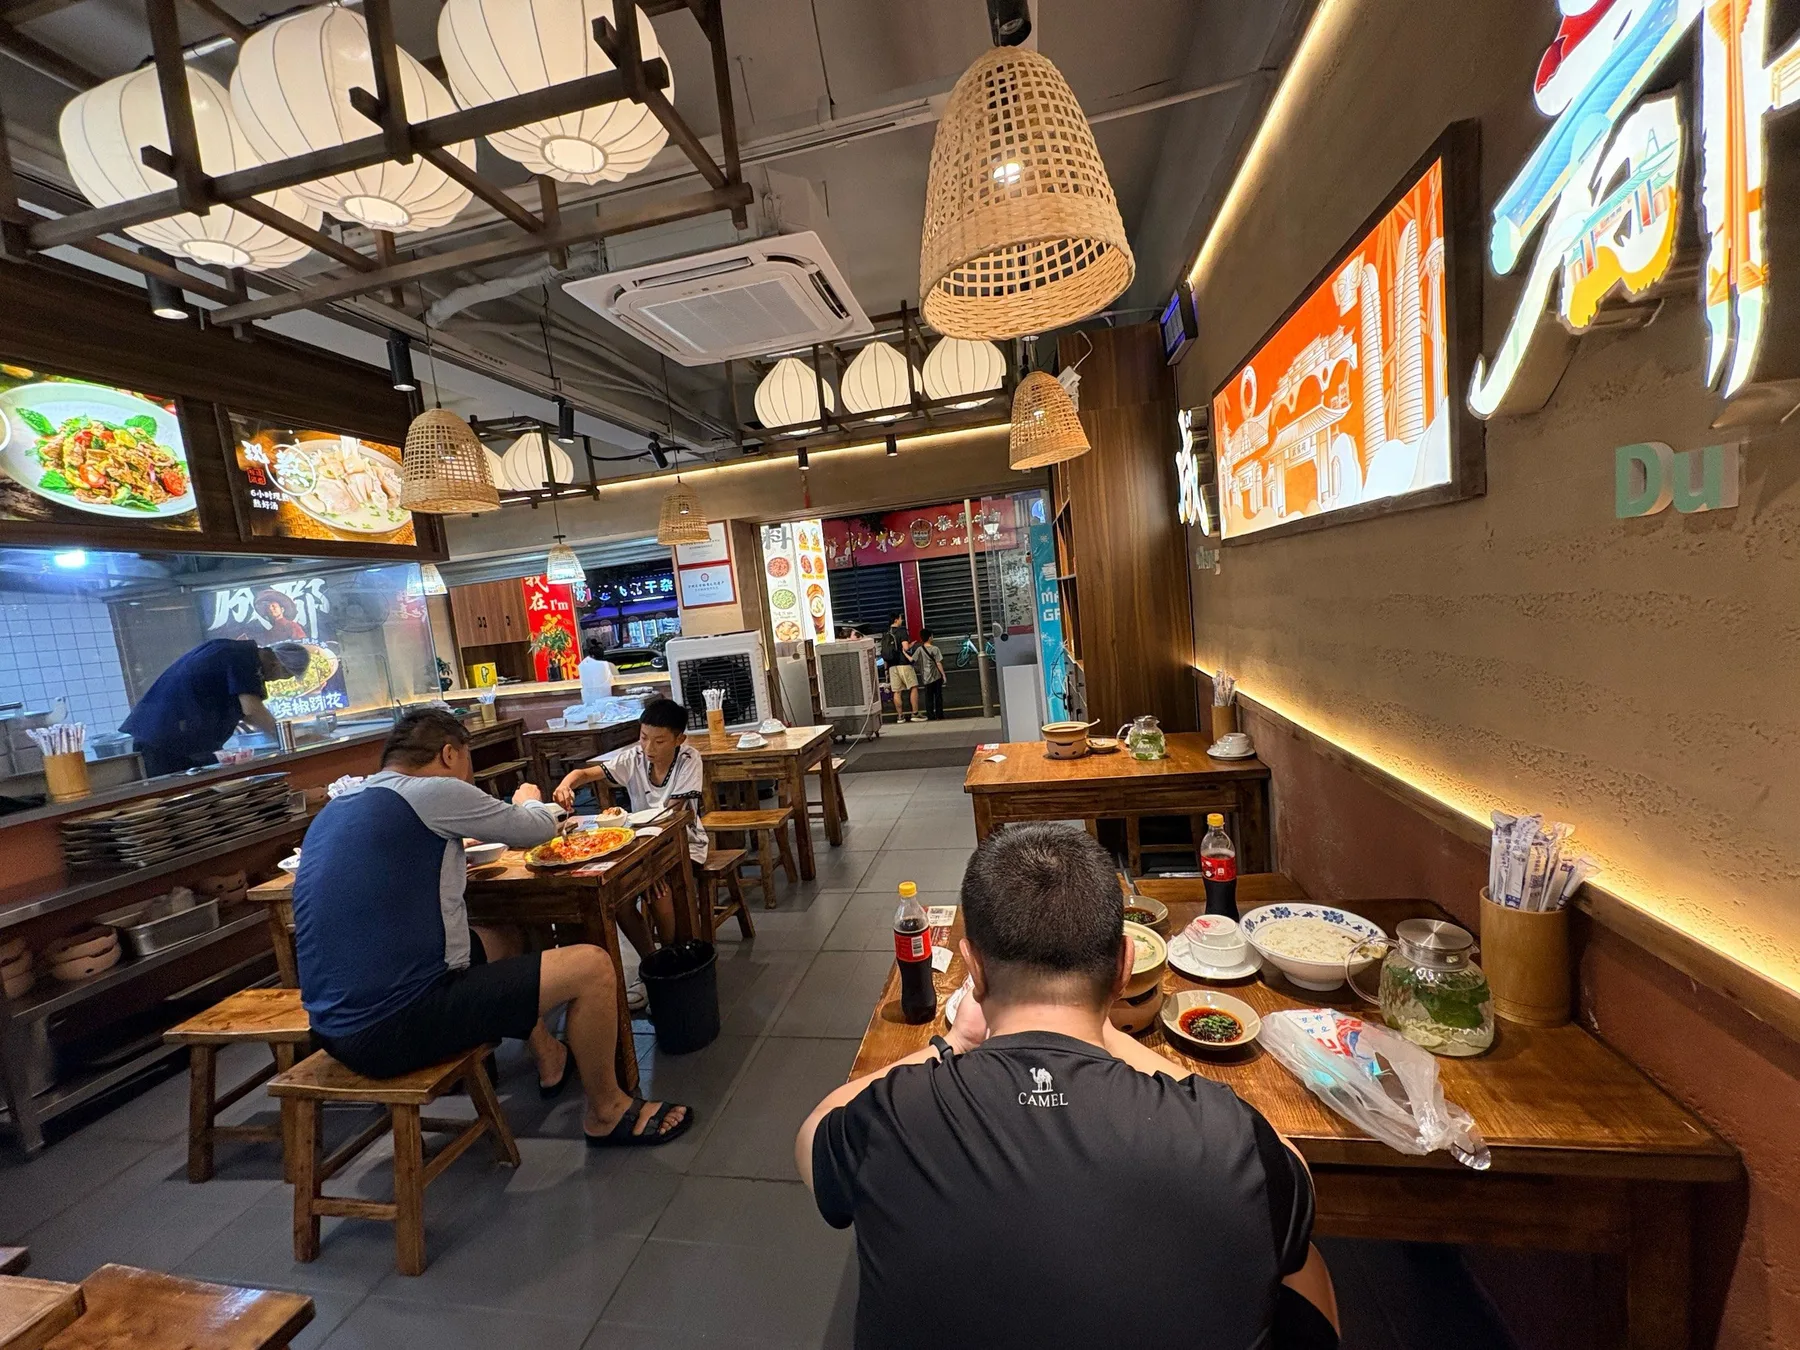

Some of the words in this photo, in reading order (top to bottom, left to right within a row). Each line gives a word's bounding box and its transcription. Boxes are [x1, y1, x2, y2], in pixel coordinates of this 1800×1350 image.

[1615, 441, 1734, 518] Du
[550, 599, 569, 611] I'm
[1018, 1092, 1069, 1107] CAMEL
